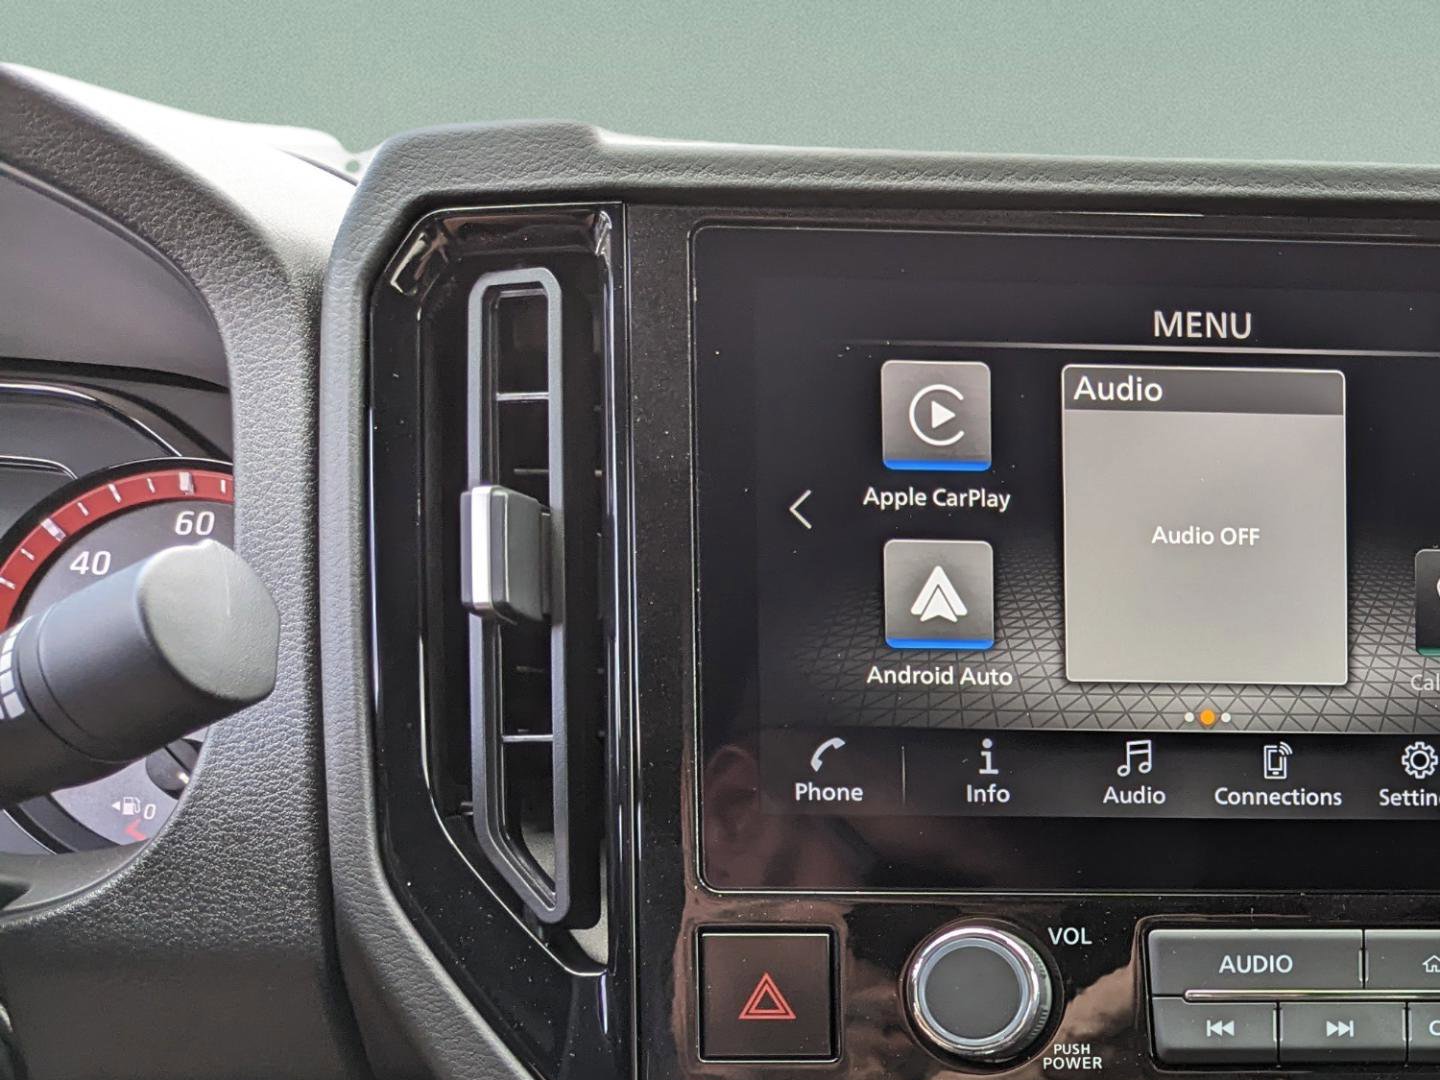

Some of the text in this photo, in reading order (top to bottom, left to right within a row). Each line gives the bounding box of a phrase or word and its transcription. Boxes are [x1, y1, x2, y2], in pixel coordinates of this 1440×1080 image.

[1153, 310, 1253, 340] MENU
[1073, 375, 1163, 402] Audio
[863, 486, 1012, 513] Apple CarPlay
[174, 510, 216, 537] 60
[1151, 525, 1261, 547] Audio OFF
[69, 550, 112, 576] 40
[866, 665, 1014, 687] Android Auto
[795, 781, 864, 803] Phone
[966, 783, 1011, 805] Info
[1103, 785, 1167, 806] Audio
[1214, 786, 1343, 807] Connections
[143, 803, 157, 821] 0
[1047, 927, 1093, 946] VOL
[1218, 953, 1294, 975] AUDIO
[1052, 1043, 1092, 1056] PUSH
[1041, 1055, 1104, 1071] POWER
